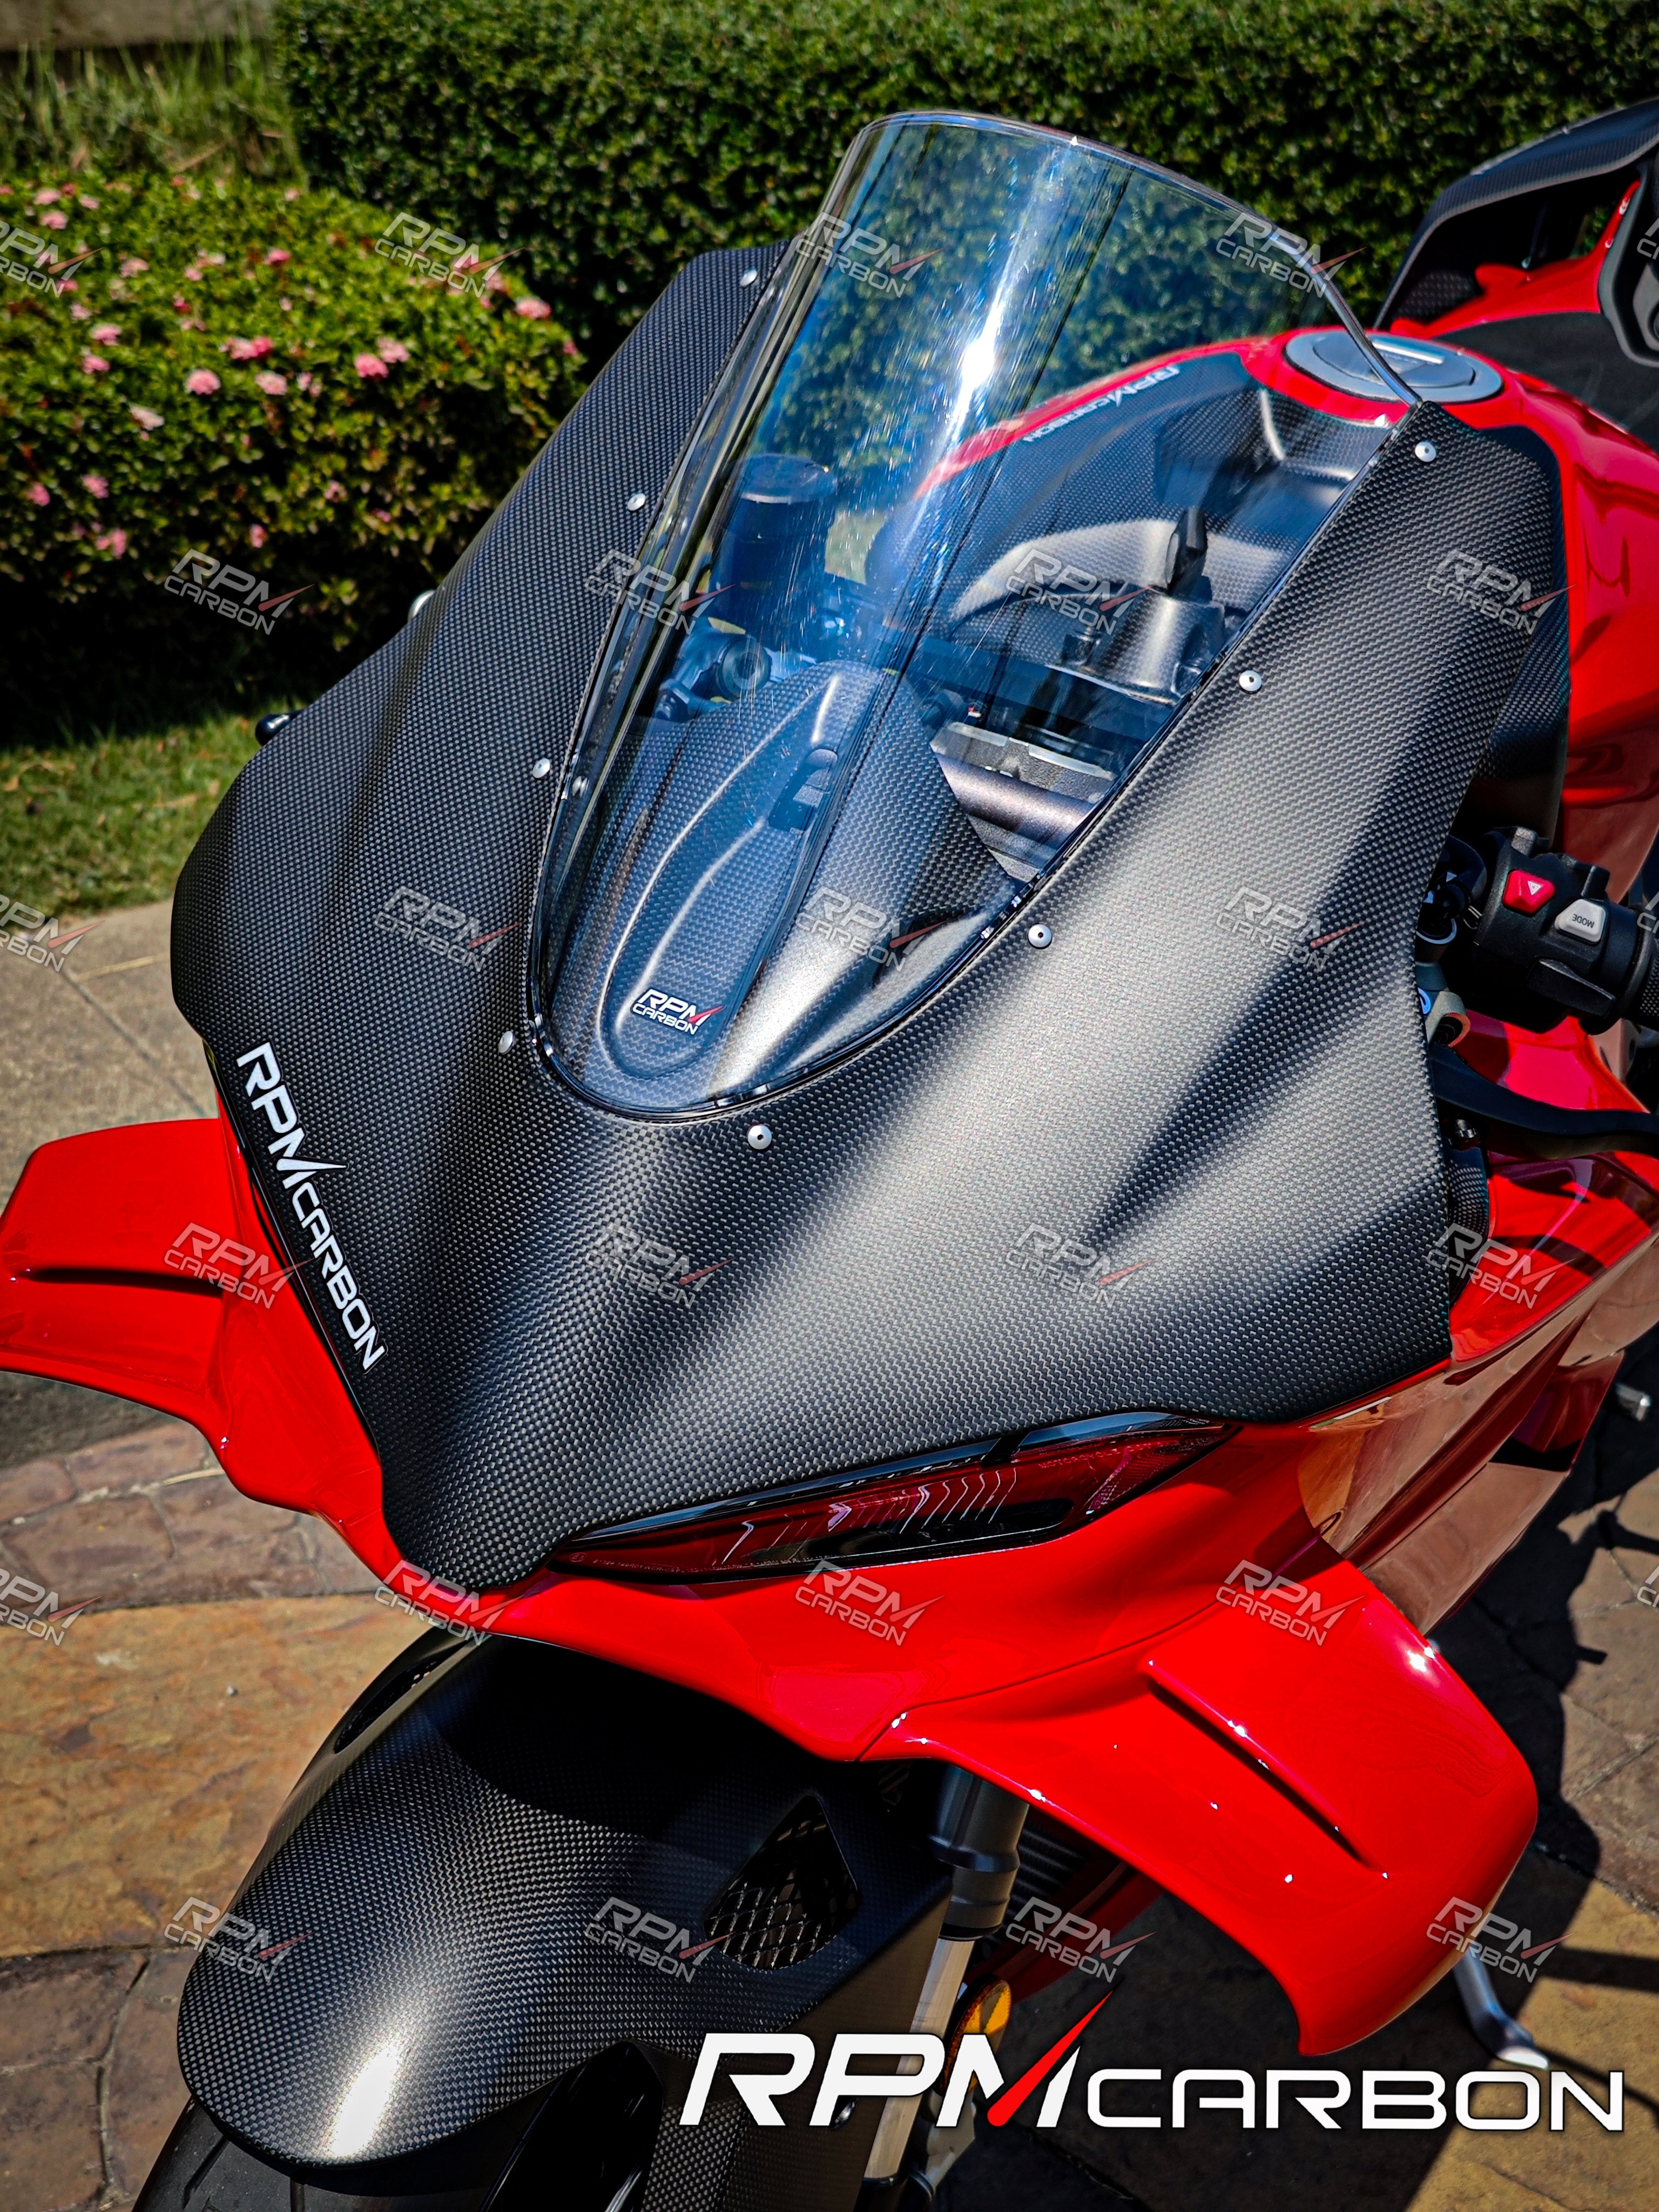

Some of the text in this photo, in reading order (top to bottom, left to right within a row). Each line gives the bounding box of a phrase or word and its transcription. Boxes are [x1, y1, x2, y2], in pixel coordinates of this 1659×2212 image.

[1572, 914, 1594, 928] MODE
[633, 1003, 698, 1035] CARBON
[638, 989, 723, 1026] RPM
[236, 1042, 385, 1370] RPM CARBON
